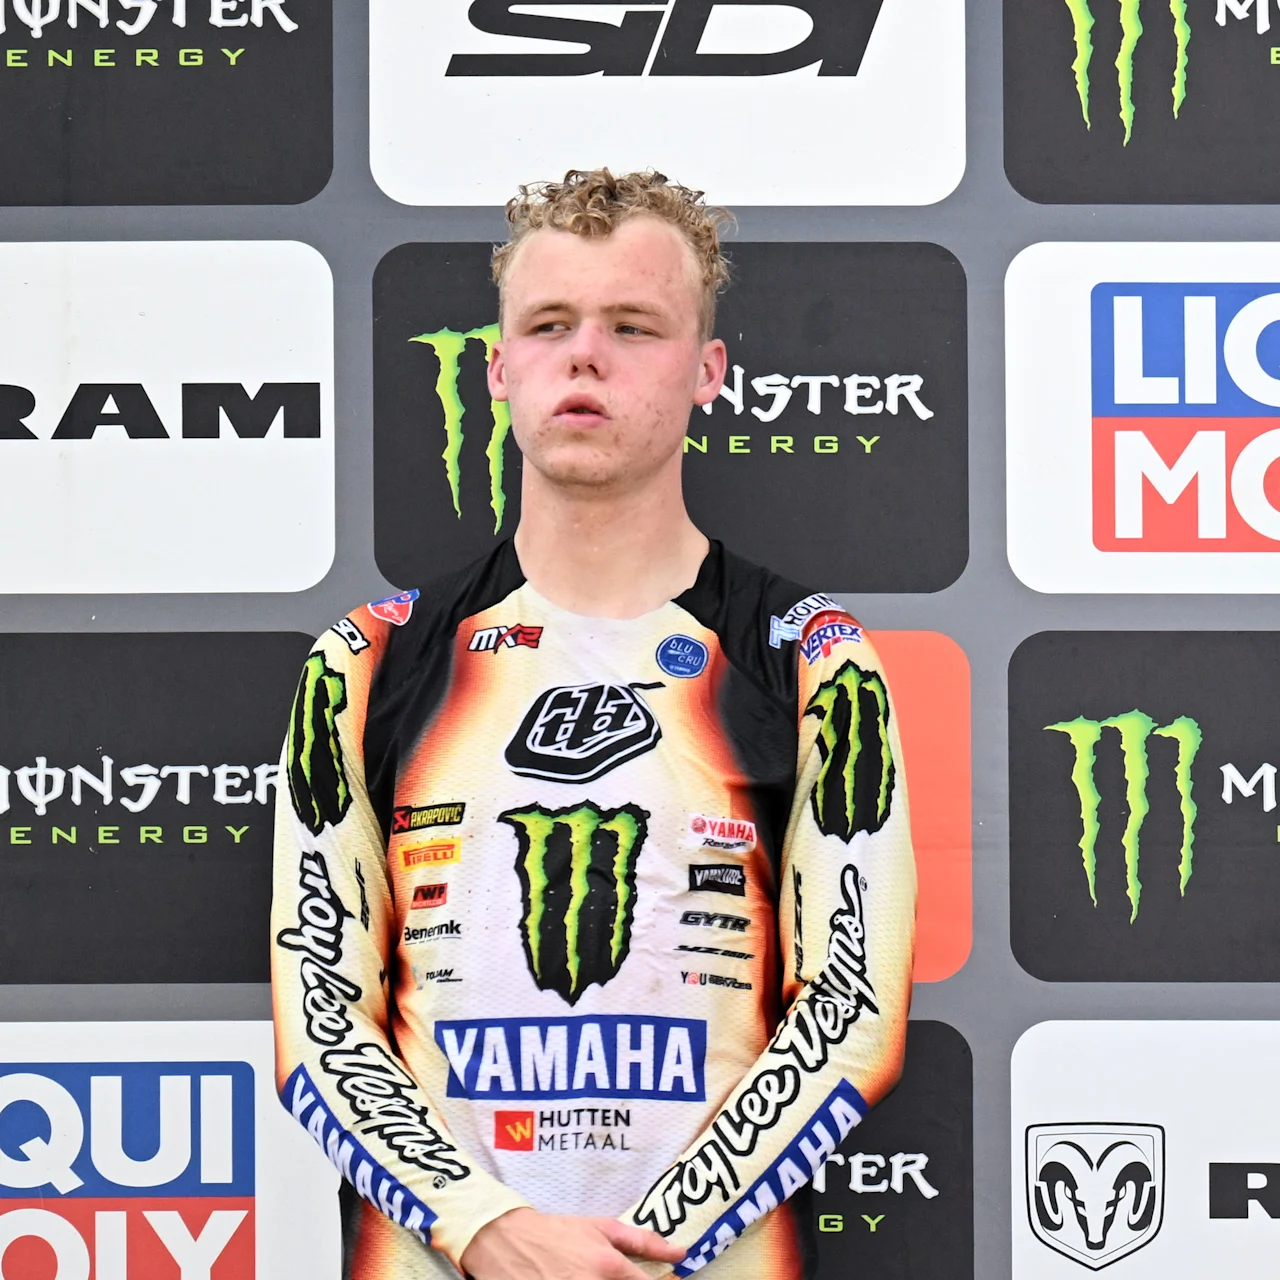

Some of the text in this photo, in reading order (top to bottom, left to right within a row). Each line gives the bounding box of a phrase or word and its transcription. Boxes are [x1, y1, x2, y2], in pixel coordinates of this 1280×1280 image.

[0, 0, 298, 38] ONSTER
[5, 48, 246, 67] ENERGY
[683, 436, 881, 454] NERGY
[10, 826, 249, 844] ENERGY
[709, 820, 755, 843] YAMAHA
[680, 910, 751, 933] GYTR
[443, 1025, 698, 1094] YAMAHA
[539, 1108, 631, 1128] HUTTEN
[538, 1132, 631, 1151] METAAL
